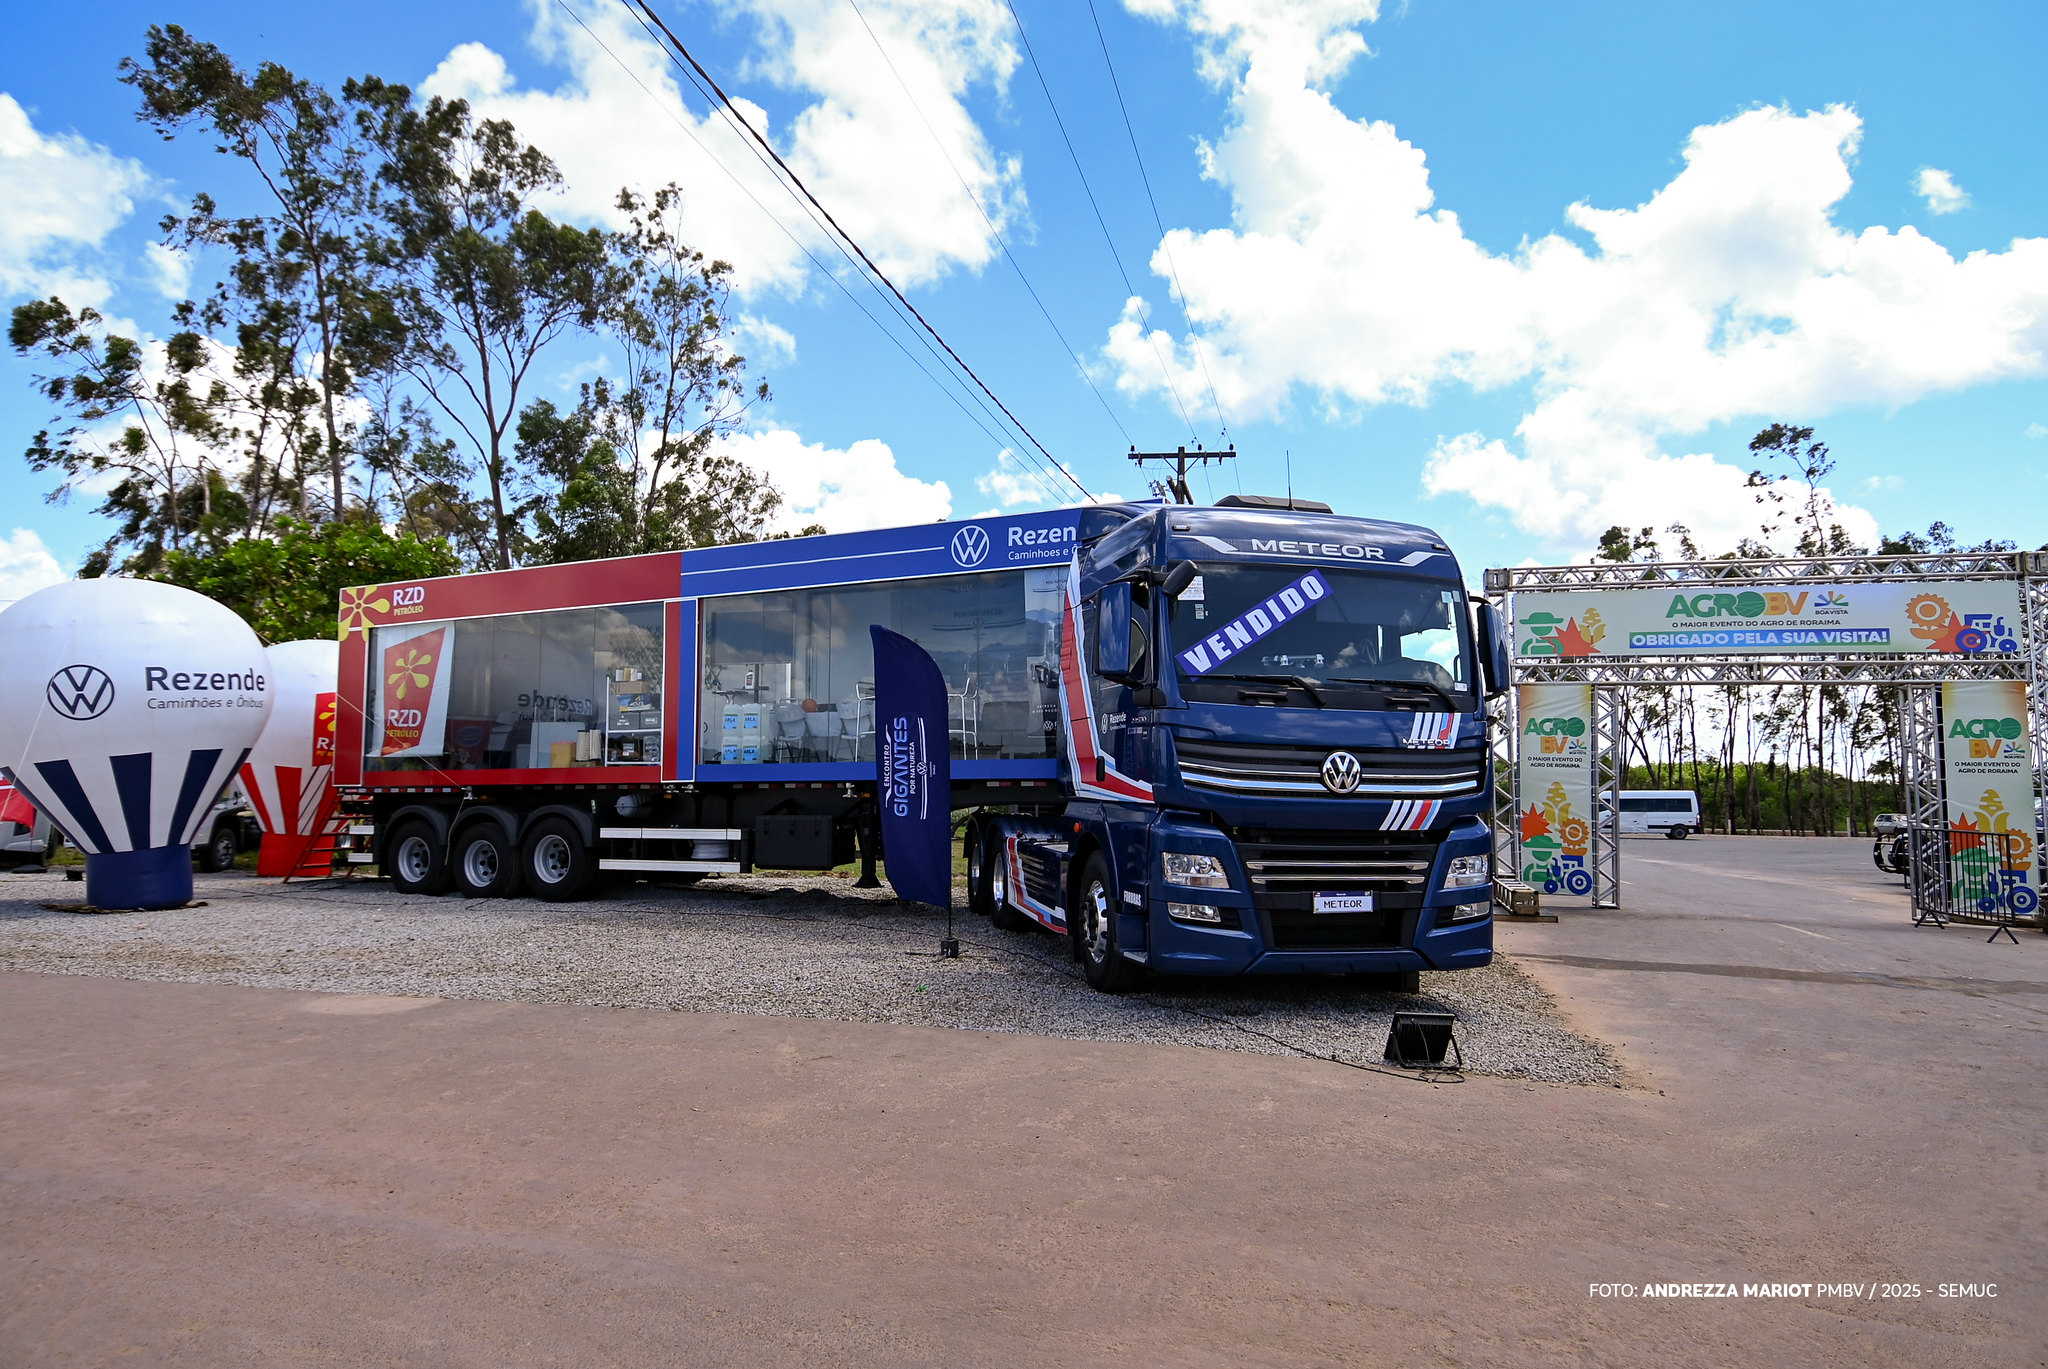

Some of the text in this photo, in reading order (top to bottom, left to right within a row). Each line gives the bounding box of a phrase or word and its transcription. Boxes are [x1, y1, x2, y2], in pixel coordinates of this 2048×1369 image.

[1251, 538, 1385, 560] METEOR
[393, 586, 425, 606] RZD
[393, 605, 424, 616] PETRÓLEO
[1183, 575, 1325, 673] VENDIDO
[1632, 631, 1888, 646] OBRIGADO PELA SUA VISITA!
[145, 667, 265, 692] Rezende
[147, 695, 264, 710] Caminhões e Ônibus
[387, 709, 422, 727] RZD
[1524, 717, 1586, 737] AGRO
[1948, 717, 2023, 740] AGRO
[1402, 738, 1450, 747] METEOR
[1541, 736, 1569, 754] BV
[1969, 739, 2003, 758] BV
[893, 716, 909, 817] GIGANTES
[1323, 899, 1362, 909] METEOR
